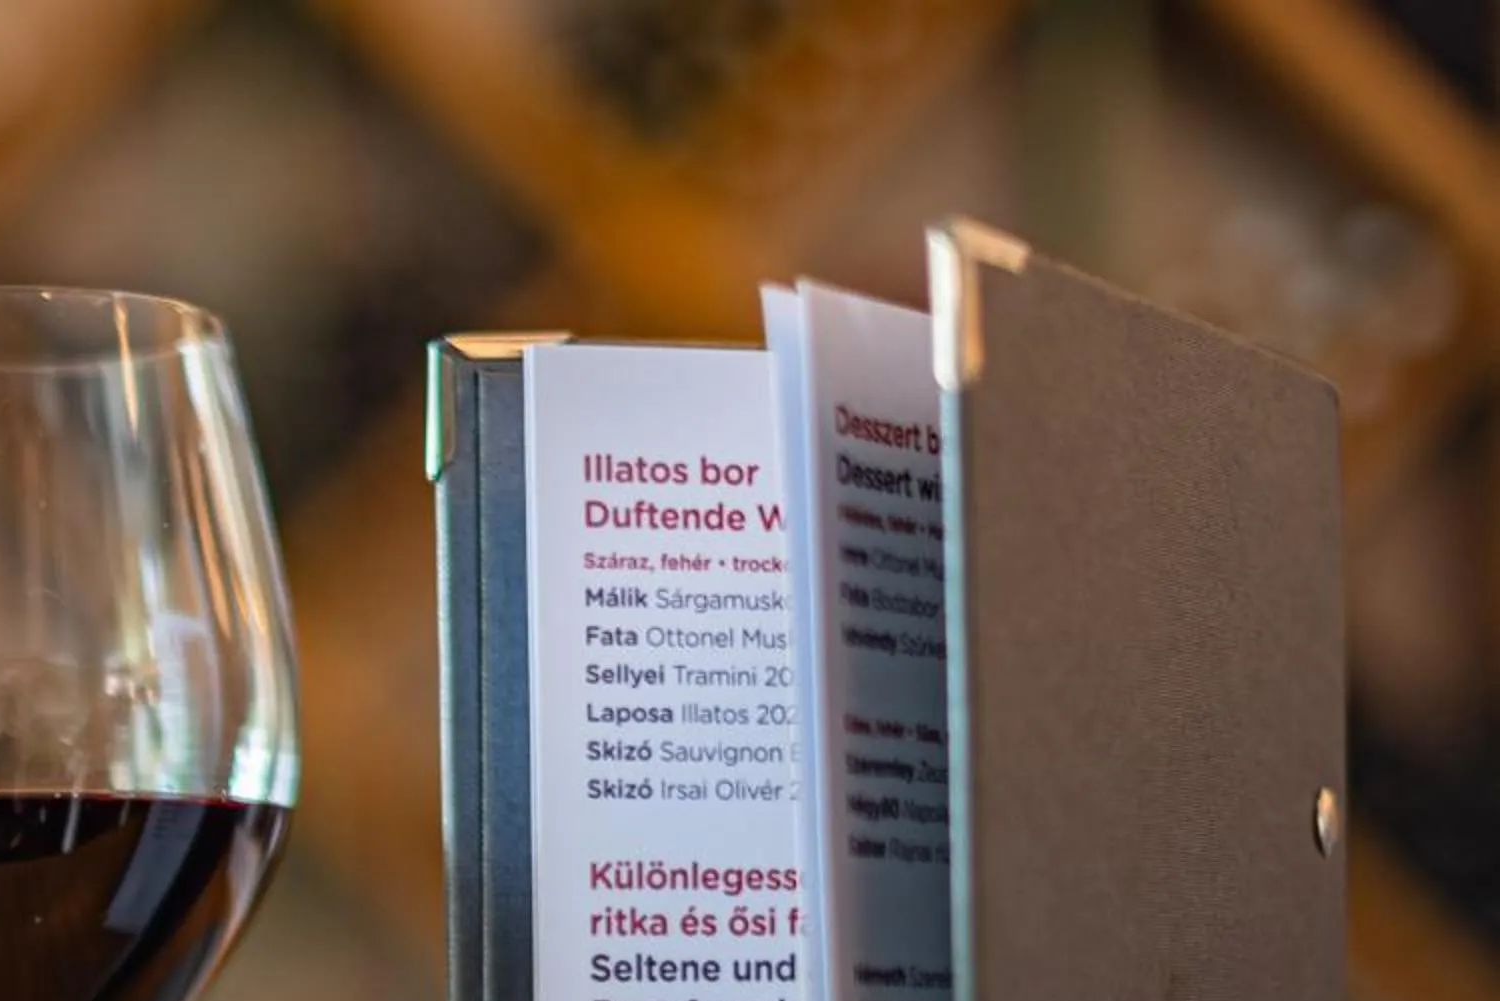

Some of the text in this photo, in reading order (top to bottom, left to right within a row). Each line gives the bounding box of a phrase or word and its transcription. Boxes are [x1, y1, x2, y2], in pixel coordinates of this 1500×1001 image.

[836, 406, 940, 455] Desszert b
[584, 454, 759, 485] Illatos bor
[837, 455, 940, 500] Dessert wi
[585, 500, 746, 531] Duftende
[583, 553, 788, 573] Száraz, fehér trock
[585, 588, 788, 613] Málik Sárgamusk
[586, 626, 790, 650] Fata Ottonel Mus
[586, 664, 794, 688] Sellyei Tramini 20
[587, 704, 799, 727] Laposa Illatos 202
[587, 741, 652, 762] Skizó
[660, 742, 782, 767] Sauvignon
[587, 779, 653, 800] Skizó
[660, 780, 706, 800] Irsai
[716, 780, 783, 800] Olivér
[591, 862, 803, 896] Különlegess
[591, 909, 668, 936] ritka
[681, 908, 717, 936] és
[729, 907, 775, 936] ősi
[591, 953, 796, 982] Seltene und
